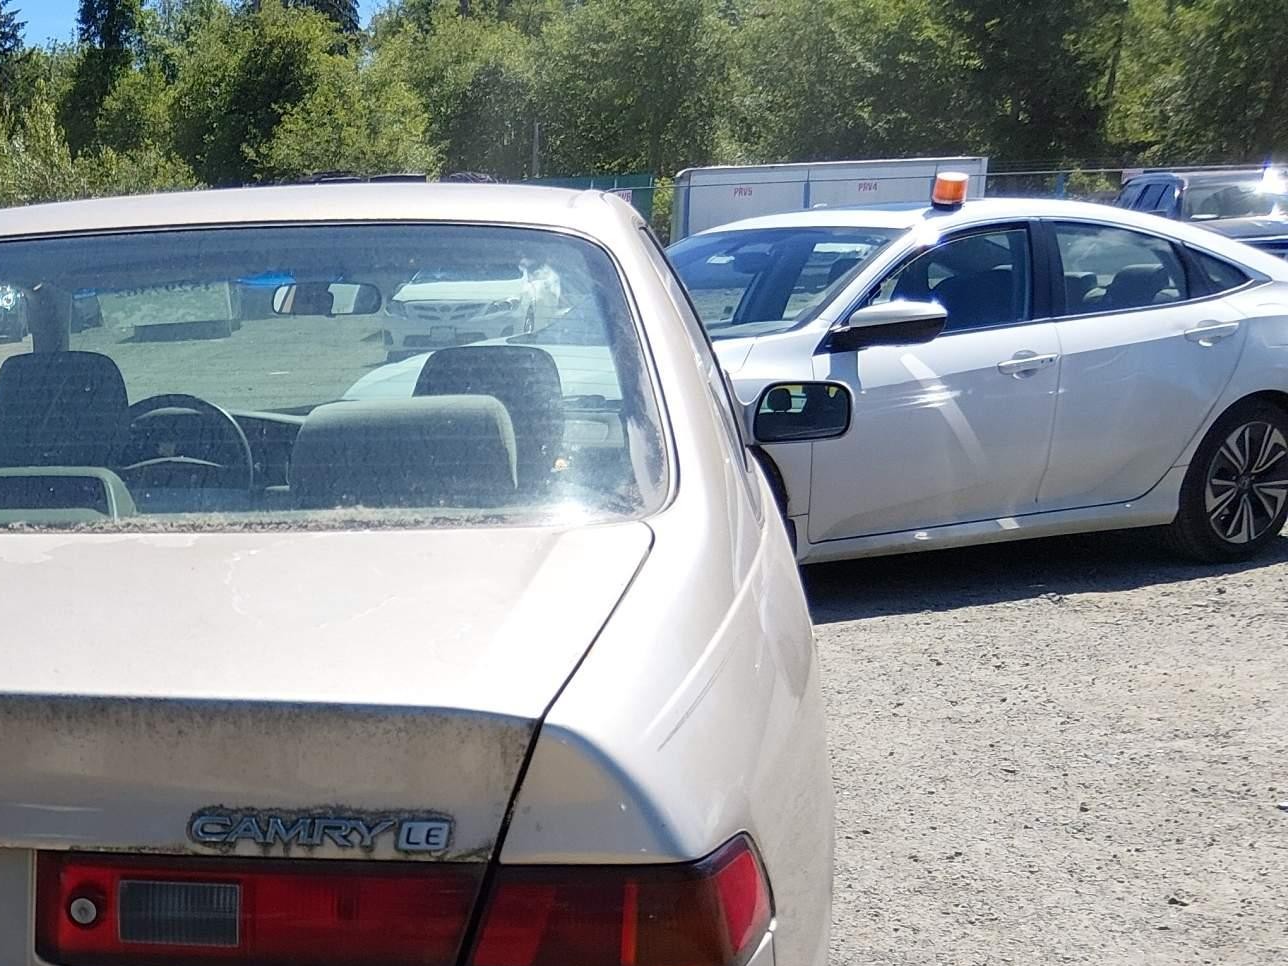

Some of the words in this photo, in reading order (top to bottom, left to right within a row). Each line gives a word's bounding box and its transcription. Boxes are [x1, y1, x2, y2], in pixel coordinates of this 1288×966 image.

[858, 182, 878, 192] PRV4
[191, 814, 397, 848] CAMRY
[403, 823, 445, 848] LE
